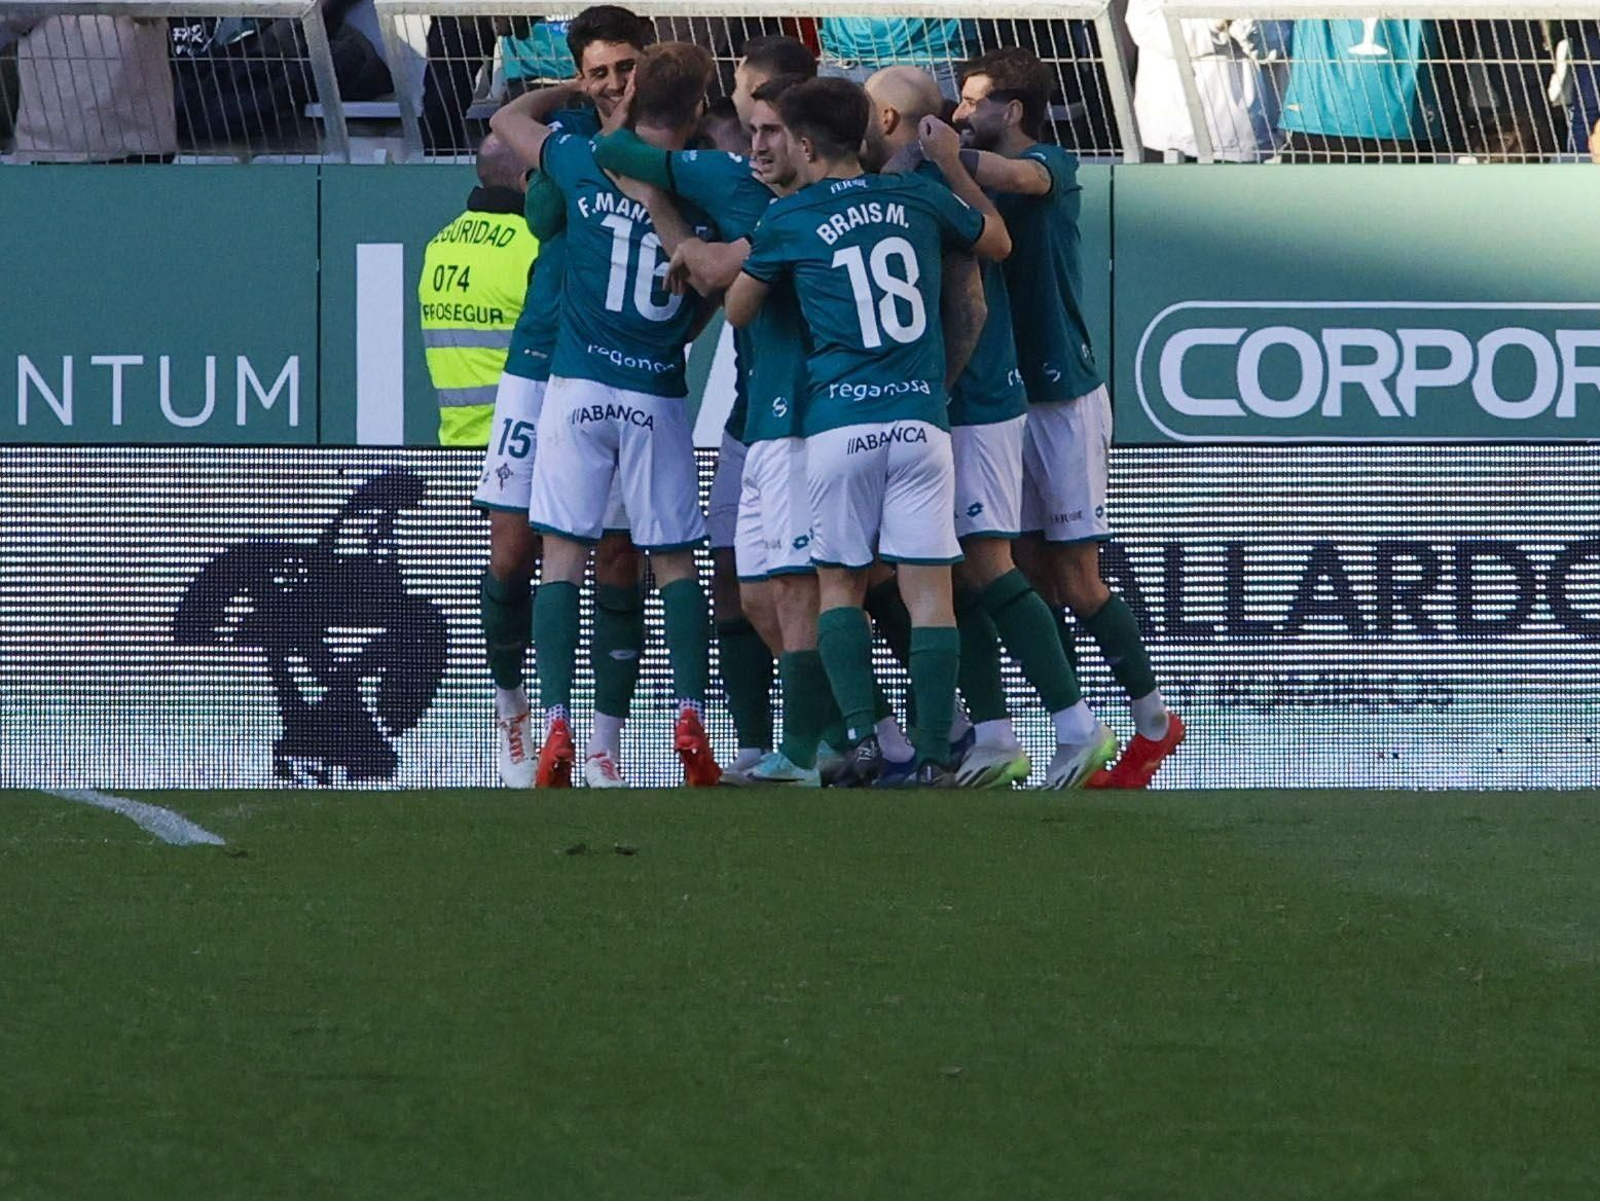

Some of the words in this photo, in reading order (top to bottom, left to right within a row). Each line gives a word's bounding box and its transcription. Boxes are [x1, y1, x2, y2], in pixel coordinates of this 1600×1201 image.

[433, 220, 517, 248] GURIDAD
[816, 202, 883, 246] BRAIS
[885, 202, 910, 229] M.
[433, 265, 471, 293] 074
[601, 213, 685, 322] 16
[831, 236, 927, 349] 18
[587, 343, 676, 374] regano
[17, 354, 300, 427] NTUM
[829, 379, 931, 401] reganosa
[497, 417, 536, 460] 15
